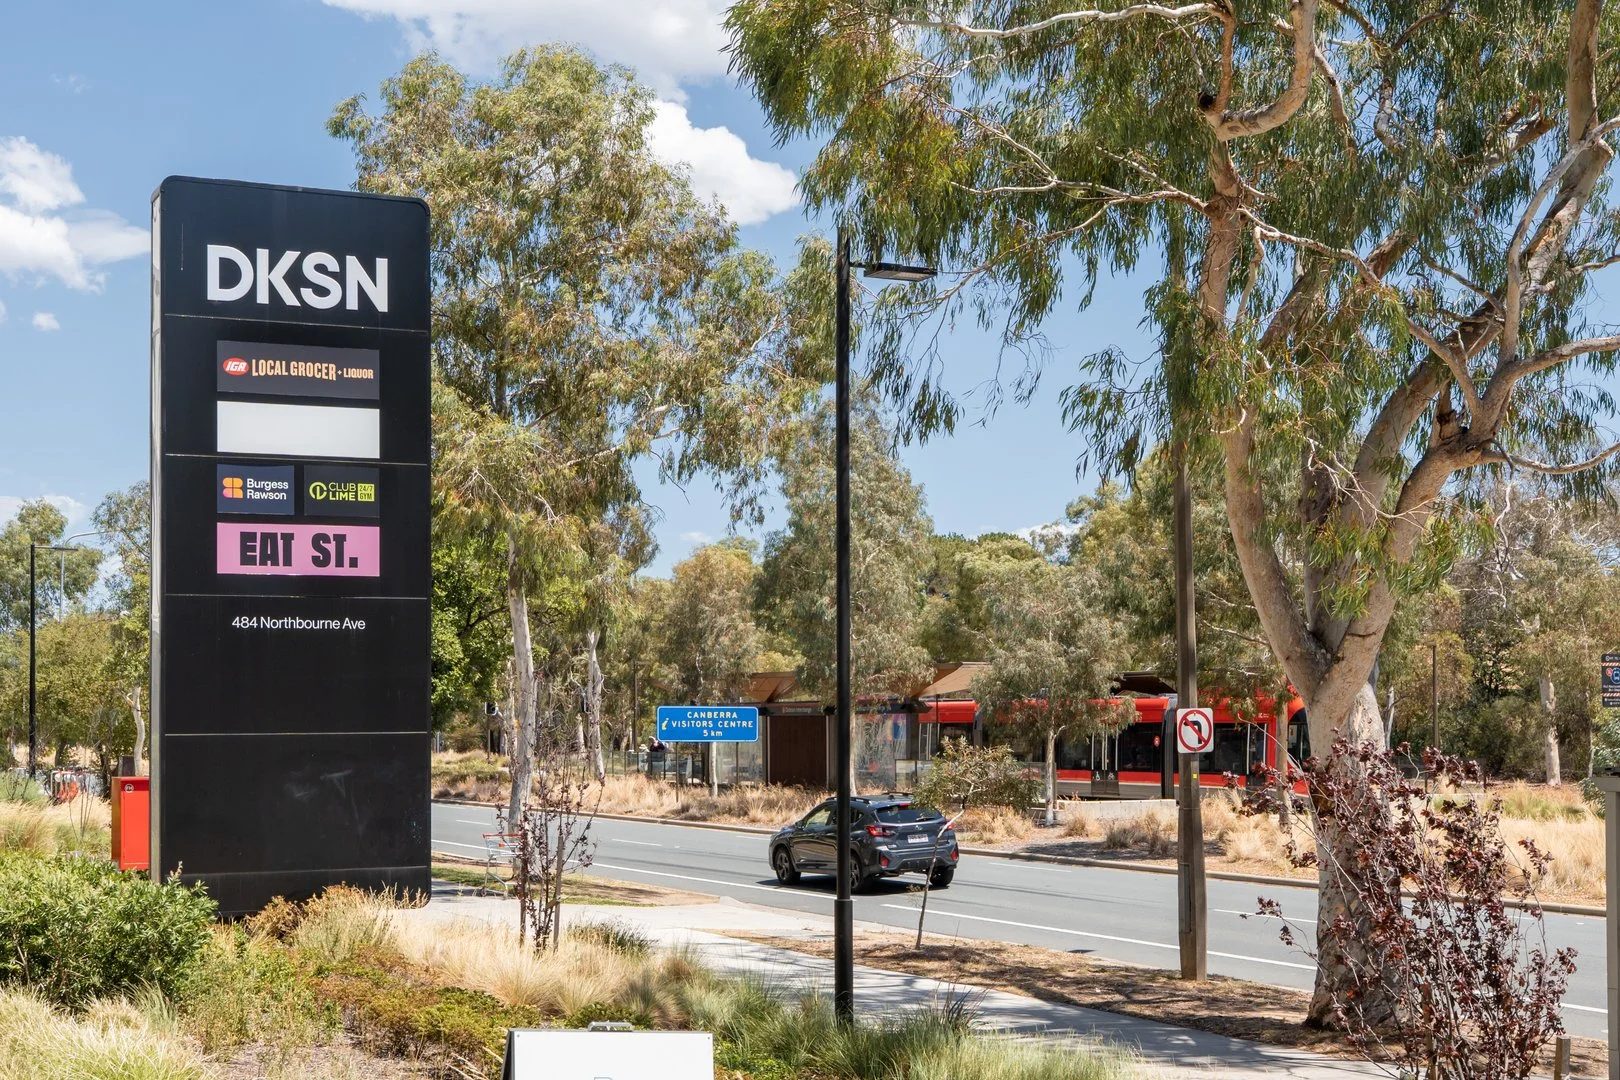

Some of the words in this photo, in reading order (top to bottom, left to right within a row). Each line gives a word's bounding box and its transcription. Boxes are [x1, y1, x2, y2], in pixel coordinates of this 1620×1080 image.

[207, 244, 389, 313] DKSN
[225, 360, 247, 372] IGA
[251, 359, 288, 377] LOCAL
[290, 361, 337, 381] GROCER
[343, 367, 374, 379] LIQUOR
[247, 478, 289, 491] Burgess
[328, 482, 356, 492] CLUB
[359, 484, 373, 492] 24/7
[247, 489, 287, 500] Rawson
[329, 492, 356, 501] LIME
[359, 492, 373, 501] GYM
[239, 531, 295, 567] EAT
[311, 532, 359, 568] ST.
[232, 616, 258, 629] 484
[260, 616, 340, 629] Northbourne
[342, 617, 366, 630] Ave
[687, 711, 738, 719] CANBERRA
[671, 720, 713, 728] VISITORS
[717, 720, 753, 728] CENTRE
[703, 729, 708, 737] 5
[710, 729, 723, 737] km
